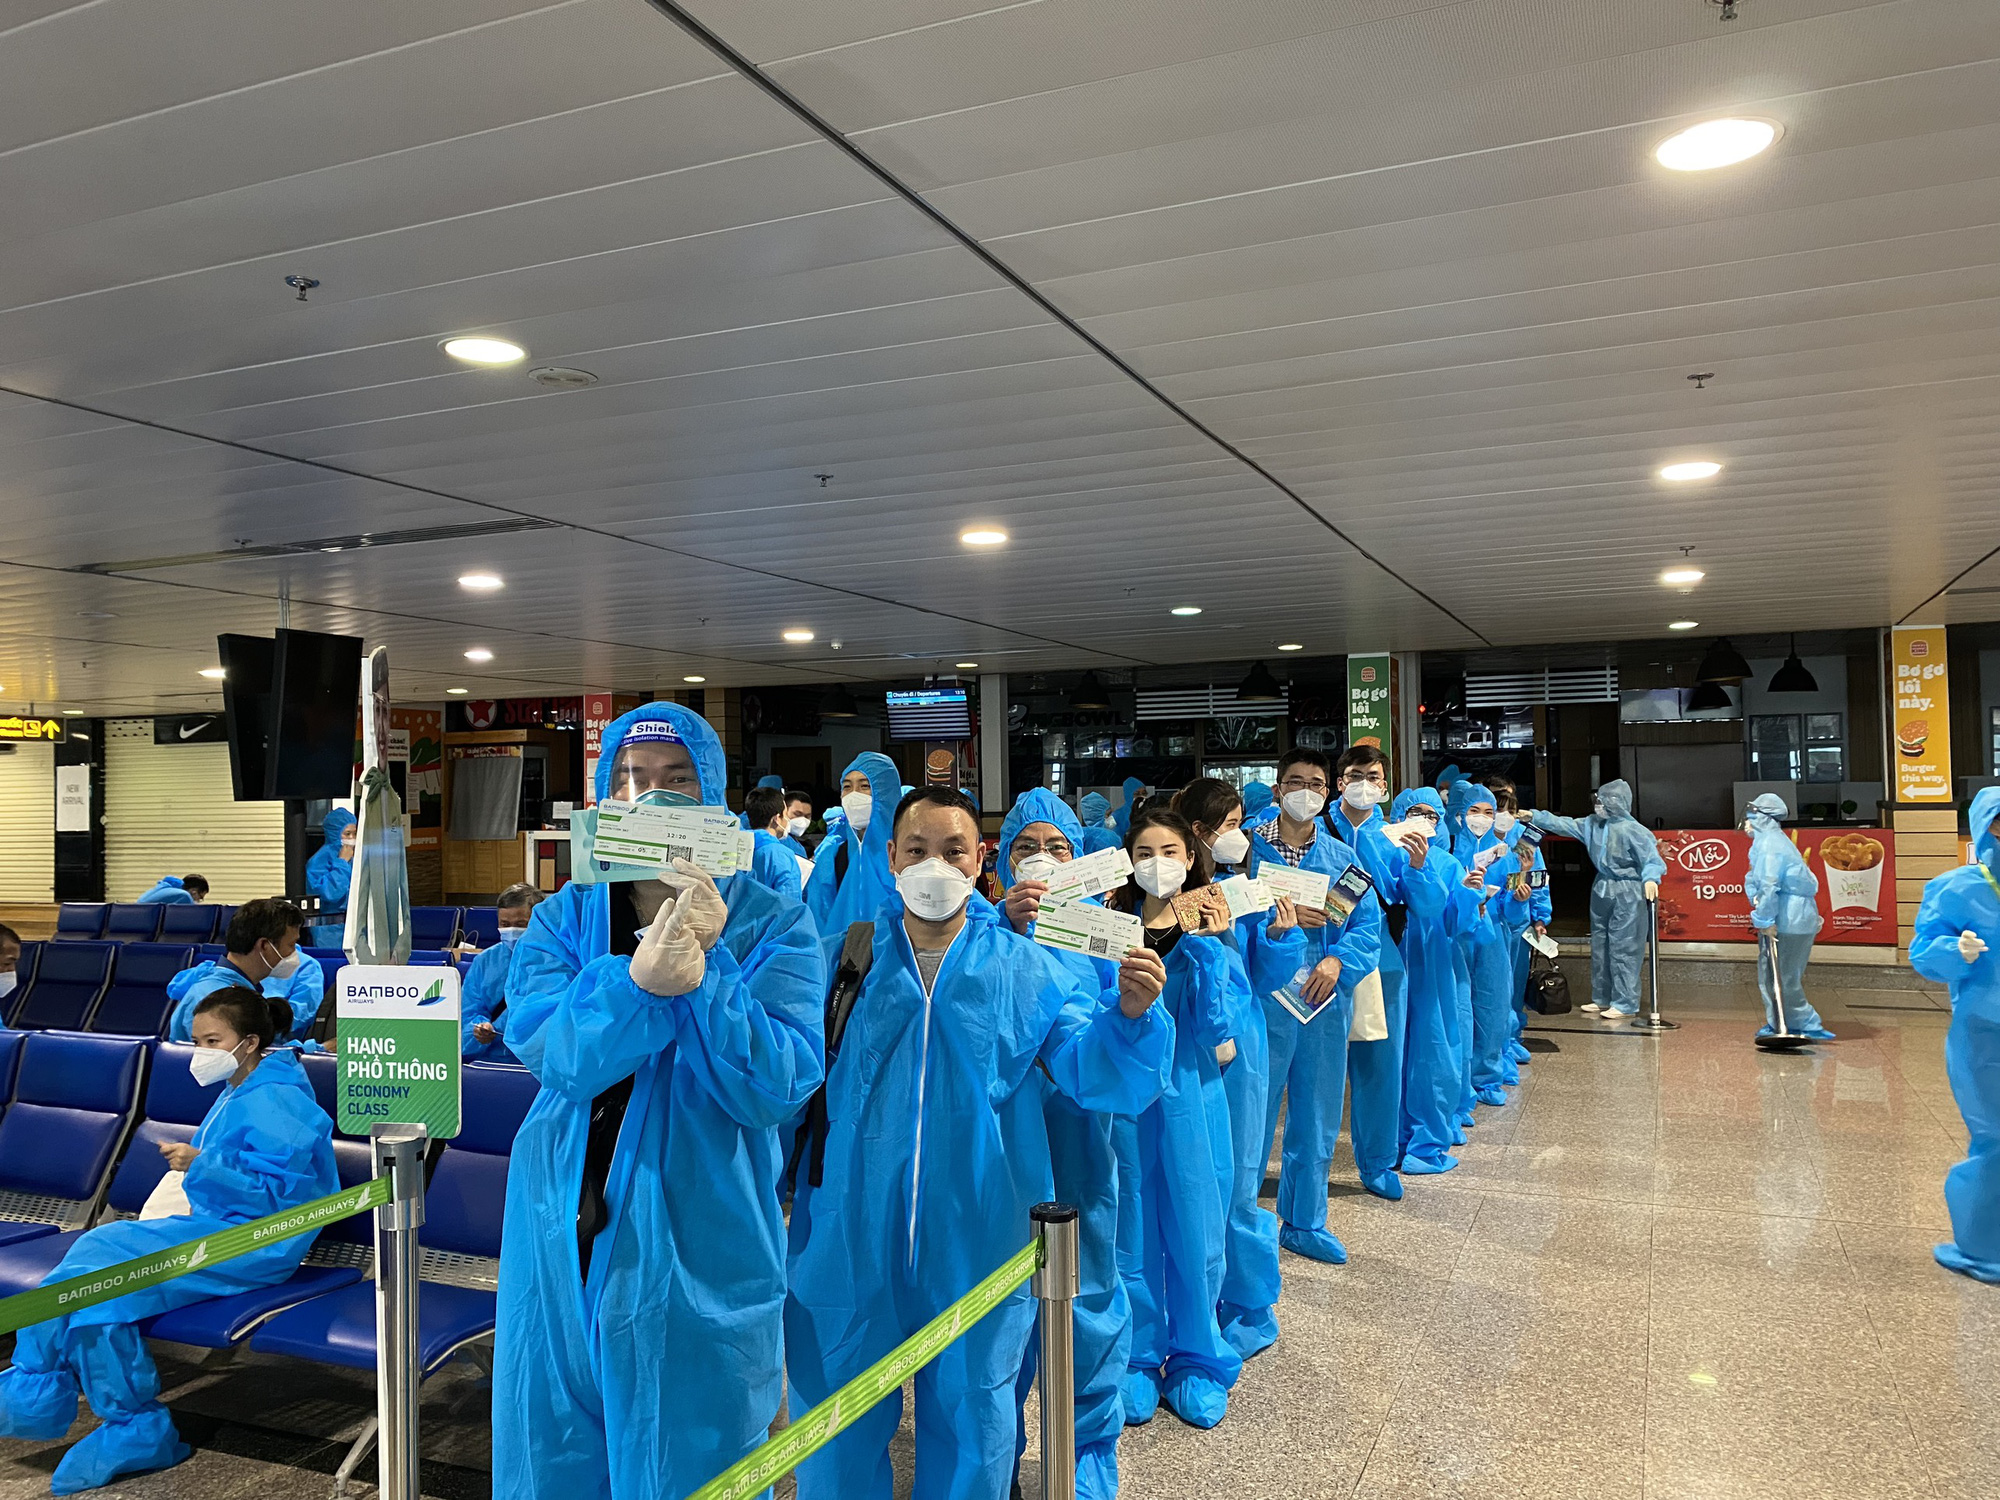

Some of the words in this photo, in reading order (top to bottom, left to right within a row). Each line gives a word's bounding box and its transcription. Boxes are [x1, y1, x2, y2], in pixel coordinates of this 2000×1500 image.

[1898, 664, 1921, 678] Bơ
[1923, 663, 1944, 679] gơ
[1898, 678, 1921, 694] lối
[1352, 688, 1369, 699] Bơ
[1371, 687, 1388, 701] gơ
[1352, 700, 1370, 714] lối
[1899, 695, 1935, 711] này.
[586, 719, 599, 729] Bơ
[1352, 715, 1380, 729] này.
[1901, 763, 1936, 773] Burger
[1902, 773, 1921, 782] this
[1922, 774, 1945, 783] way.
[411, 837, 438, 845] HOPPER
[667, 832, 687, 840] 12:20
[919, 892, 931, 900] 3M
[1692, 884, 1743, 900] 19.000
[347, 985, 419, 998] BAMBOO
[347, 1037, 396, 1059] HẠNG
[347, 1054, 383, 1079] PHỔ
[386, 1058, 448, 1081] THÔNG
[348, 1084, 411, 1098] ECONOMY
[348, 1102, 389, 1116] CLASS
[253, 1215, 305, 1240] BAMBOO
[307, 1197, 356, 1222] AIRWAYS
[58, 1275, 124, 1304] BAMBOO
[127, 1254, 188, 1281] AIRWAYS
[985, 1271, 1014, 1303] BAMBOO
[1013, 1249, 1041, 1278] AIRWAYS
[878, 1352, 916, 1390] BAMBOO
[917, 1323, 950, 1357] AIRWAYS
[722, 1456, 778, 1500] BAMBOO
[778, 1419, 826, 1462] AIRWAYS
